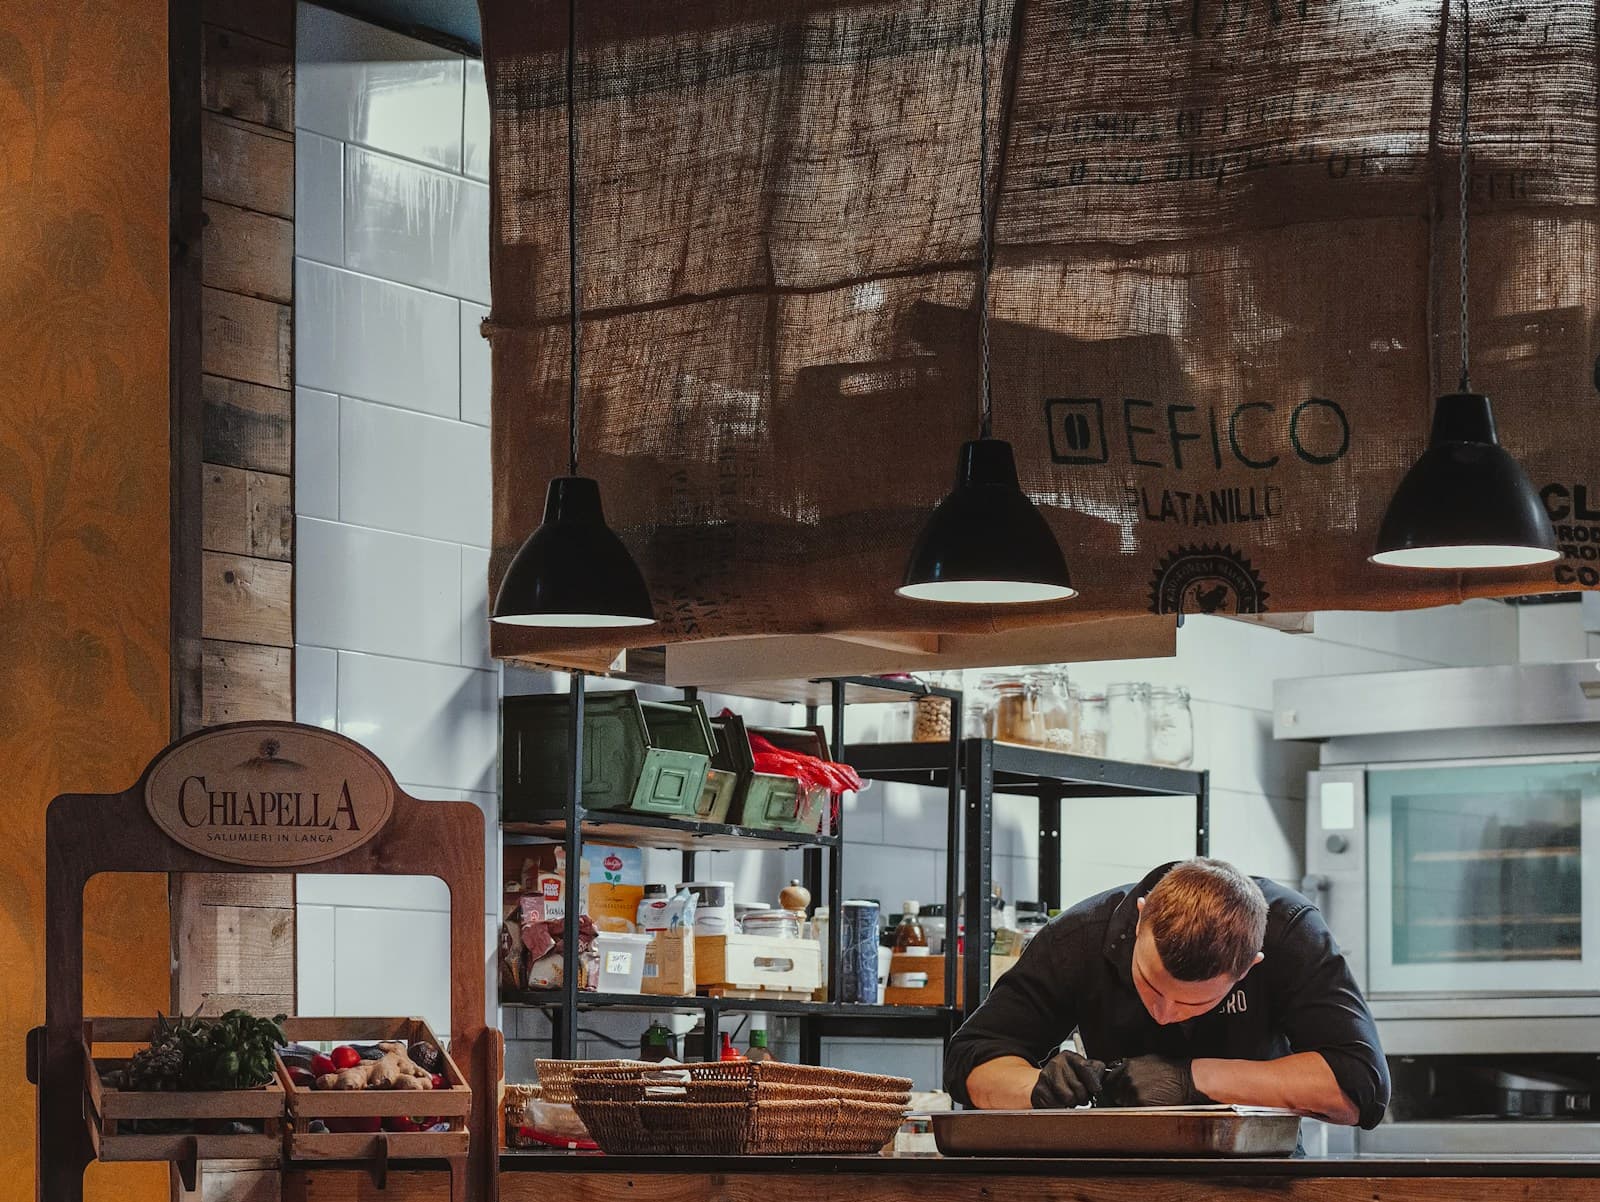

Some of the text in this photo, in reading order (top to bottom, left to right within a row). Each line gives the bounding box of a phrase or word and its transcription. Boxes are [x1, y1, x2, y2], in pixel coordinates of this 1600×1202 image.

[1124, 397, 1350, 470] EFICO
[177, 775, 361, 831] CHIAPELLA
[207, 832, 334, 843] SALUMIERI IN LANGA
